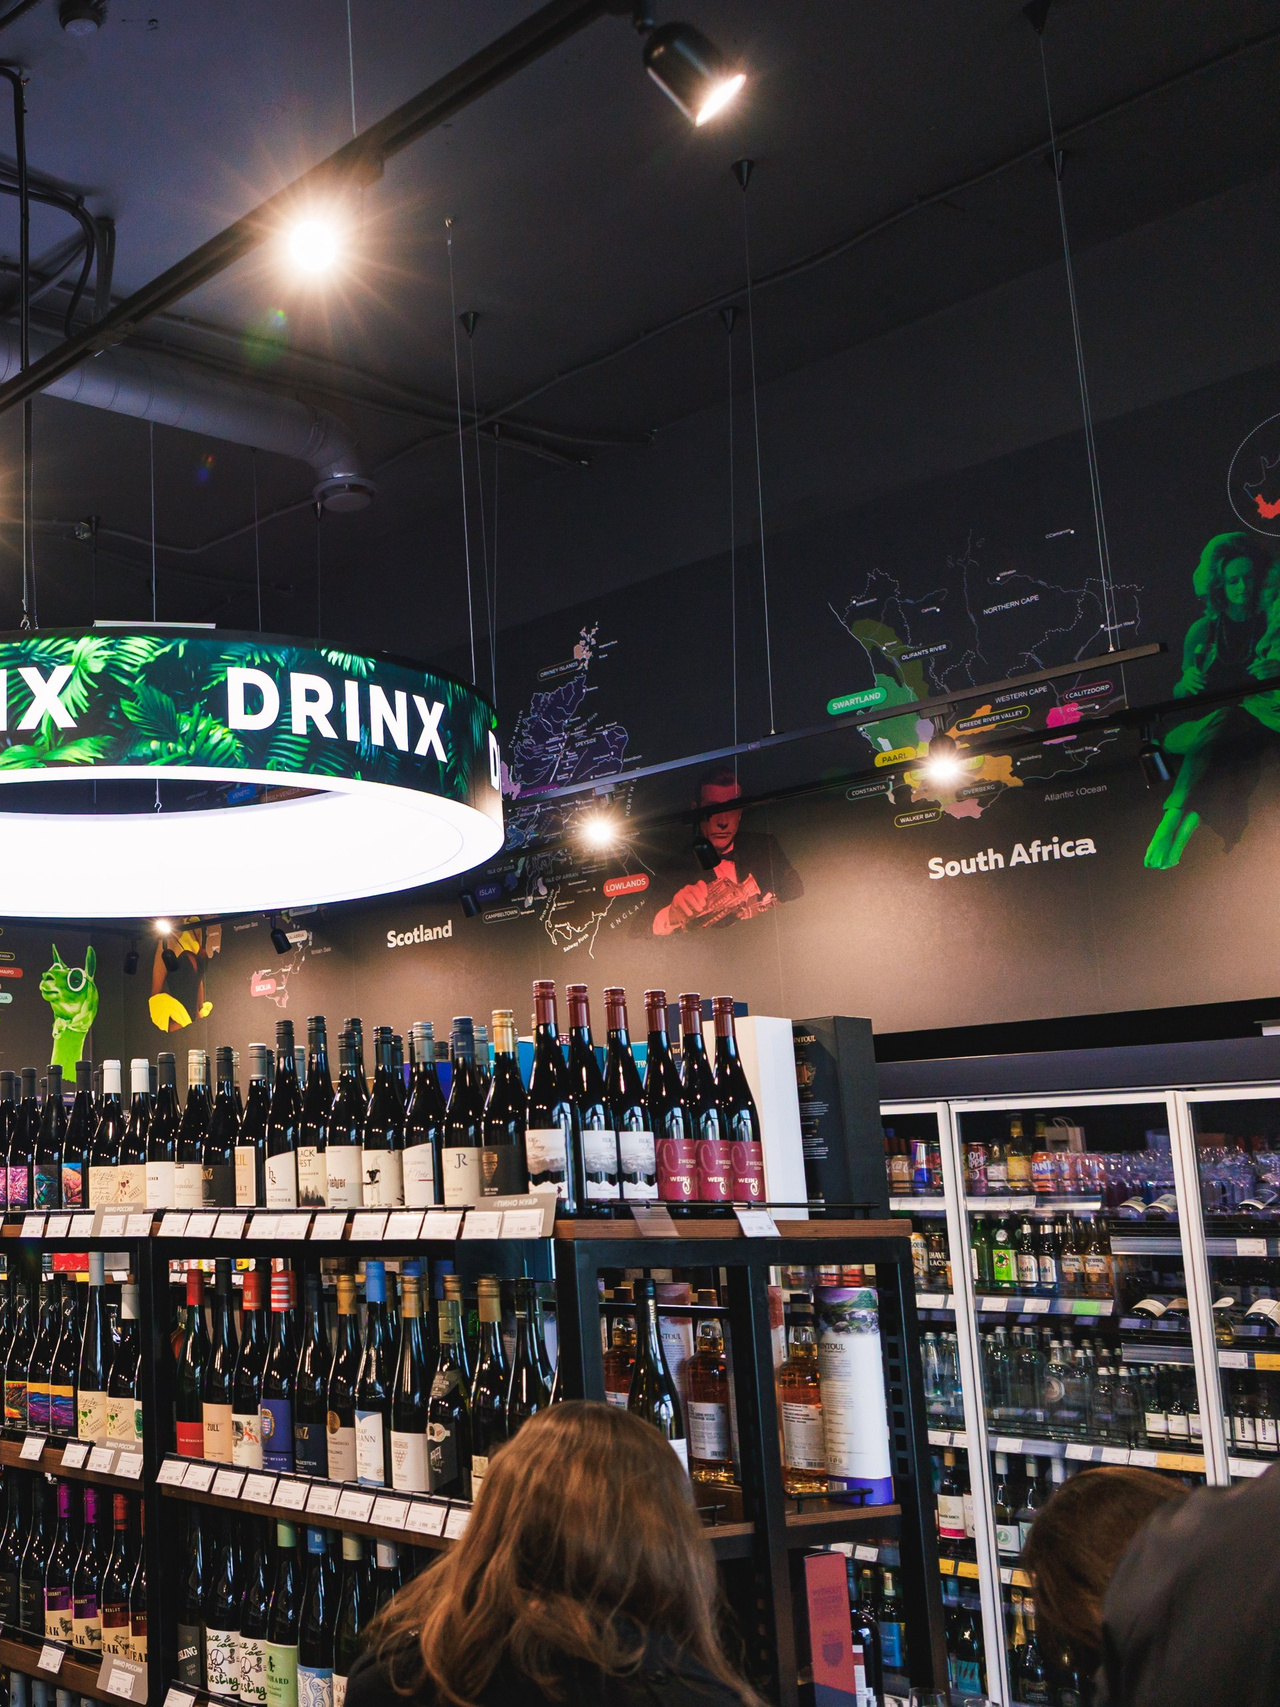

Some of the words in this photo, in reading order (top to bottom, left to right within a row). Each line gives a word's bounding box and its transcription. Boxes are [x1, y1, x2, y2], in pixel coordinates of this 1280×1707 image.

[983, 600, 1020, 615] NORTHERN
[1020, 594, 1039, 605] CAPE
[929, 644, 947, 653] RIVER
[832, 692, 881, 710] SWARTLAND
[995, 691, 1028, 704] WESTERN
[1029, 686, 1048, 697] CAPE
[227, 667, 448, 763] DRINX
[959, 717, 982, 729] BREEDE
[982, 715, 1000, 724] RIVER
[1001, 710, 1024, 720] VALLEY
[575, 737, 597, 747] SPEYSIDE
[882, 751, 908, 763] PAARL
[851, 784, 886, 796] CONSTANTIA
[963, 784, 996, 796] OVERBERG
[1044, 791, 1074, 802] Atlantic
[900, 814, 923, 824] WALKER
[924, 811, 936, 820] BAY
[928, 848, 1005, 879] South
[1009, 836, 1097, 867] Africa
[478, 887, 497, 896] ISLAY
[605, 878, 646, 893] LOWLANDS
[484, 909, 519, 920] CAMPBELTOWN
[386, 919, 453, 949] Scotland
[207, 1423, 220, 1432] ZULL
[119, 1443, 136, 1451] РОССИИ
[112, 1659, 126, 1668] ВИНО
[125, 1662, 143, 1673] РОССИИ
